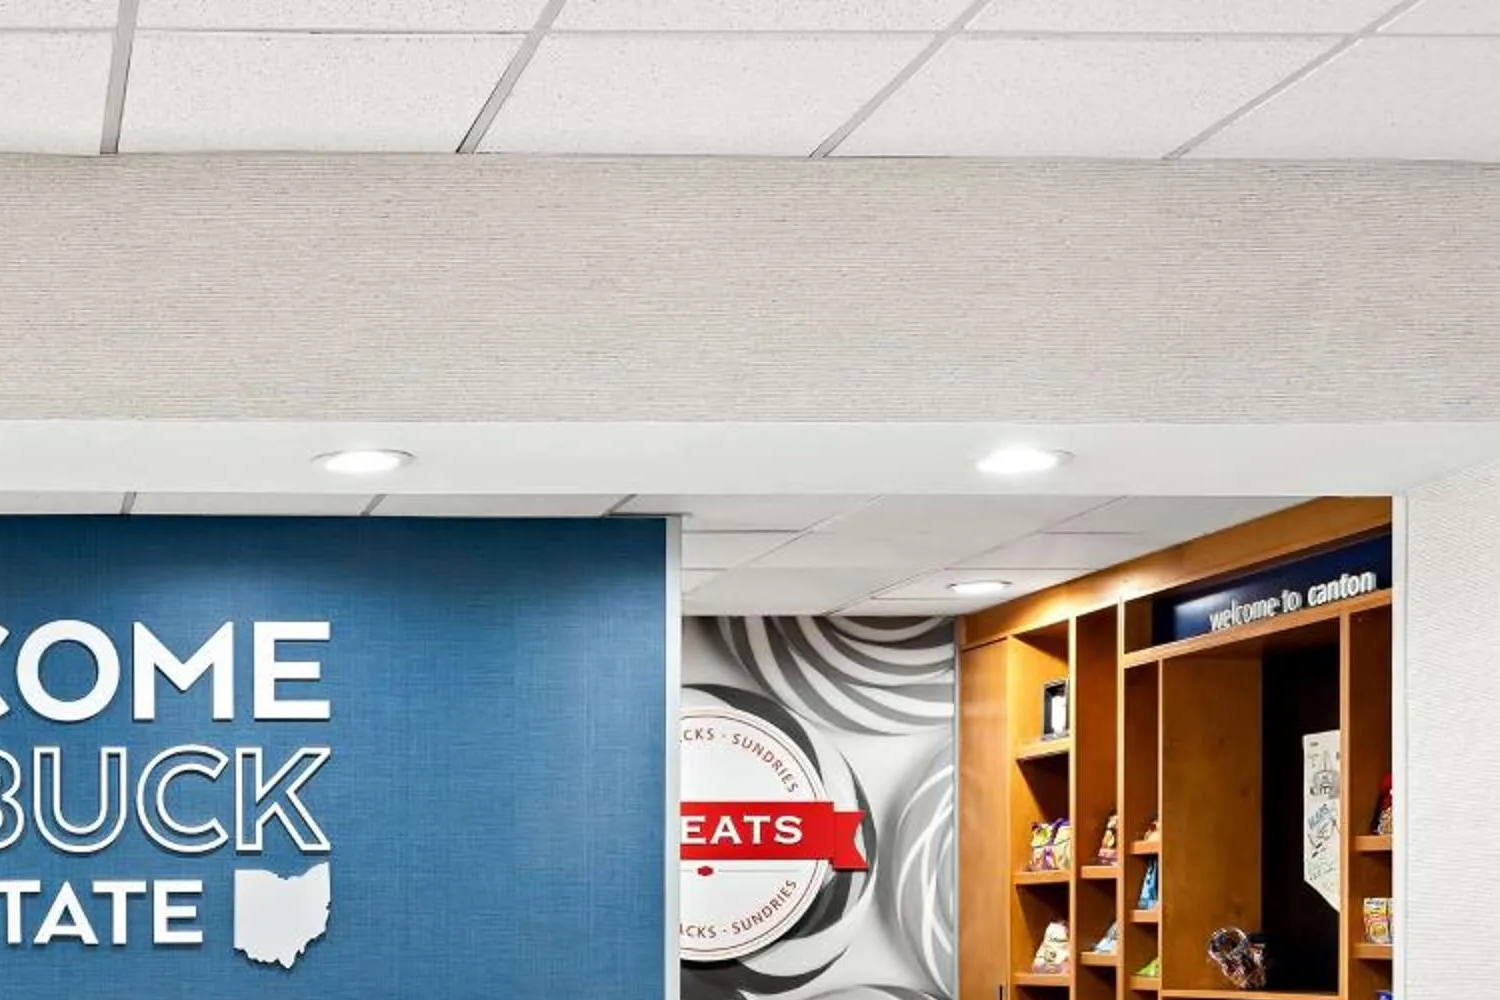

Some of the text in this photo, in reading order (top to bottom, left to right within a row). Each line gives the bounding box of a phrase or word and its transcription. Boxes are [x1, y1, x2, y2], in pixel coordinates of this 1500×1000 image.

[1209, 570, 1377, 631] welcome to canton
[680, 727, 799, 793] CKS SUNDRIES
[681, 814, 804, 845] EATS
[731, 879, 797, 936] SUNDRIES
